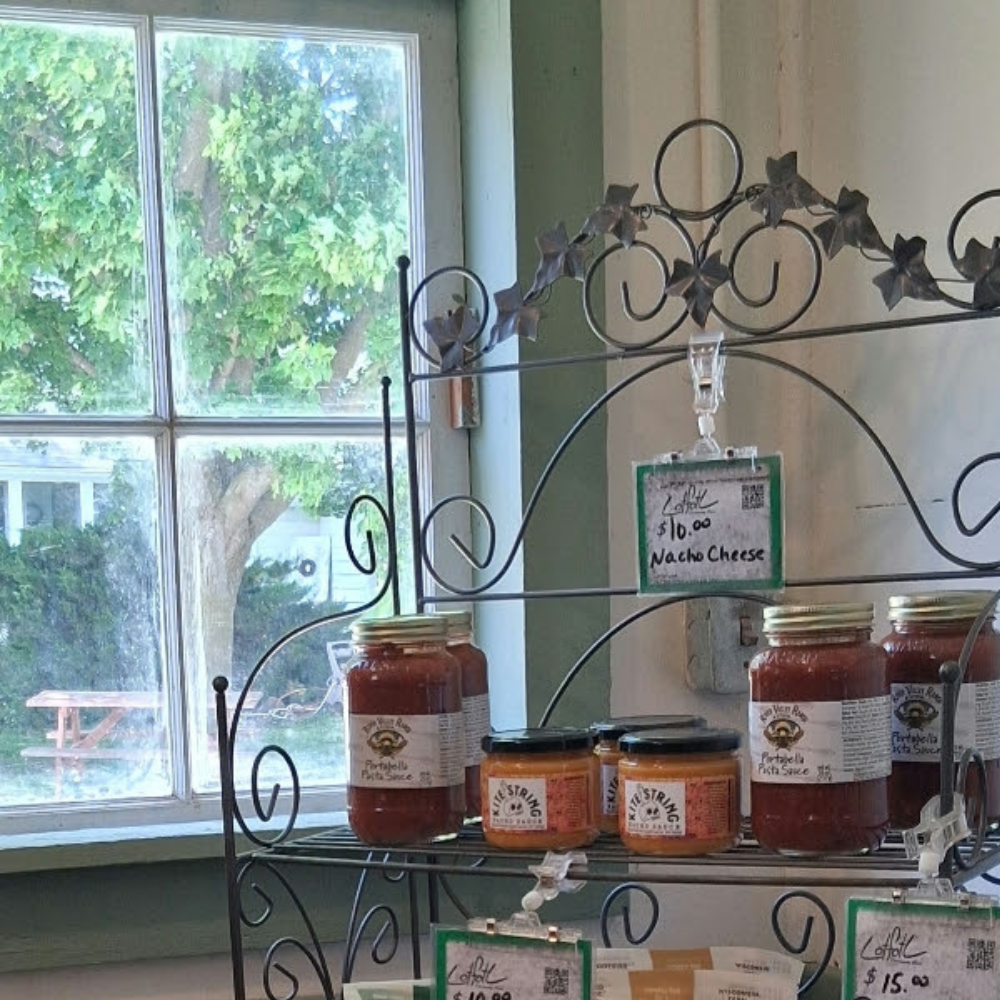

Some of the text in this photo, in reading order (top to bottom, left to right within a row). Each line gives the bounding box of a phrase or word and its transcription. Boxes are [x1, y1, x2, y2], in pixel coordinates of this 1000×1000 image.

[650, 545, 765, 568] Nacho Cheese
[492, 784, 543, 818] KITE STRING
[628, 788, 680, 823] KITE STRING
